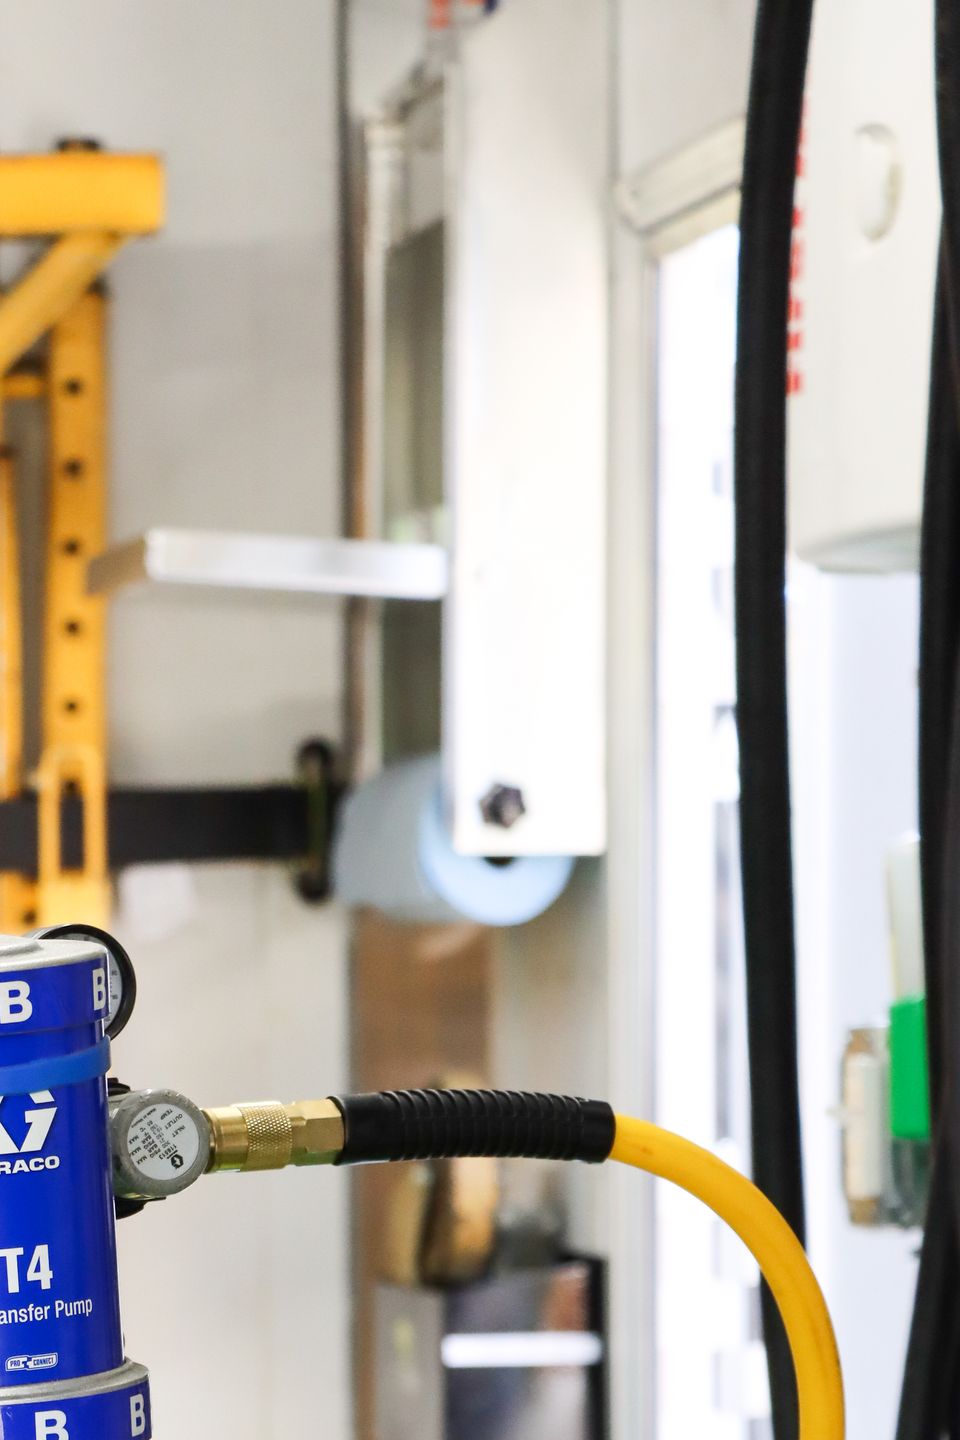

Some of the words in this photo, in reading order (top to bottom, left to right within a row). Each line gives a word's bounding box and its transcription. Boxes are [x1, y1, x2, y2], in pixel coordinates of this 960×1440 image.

[93, 967, 106, 1011] B
[160, 1108, 173, 1120] TEMP
[164, 1113, 183, 1130] OUTLET
[55, 1298, 93, 1318] Pump
[33, 1357, 54, 1366] CONNECT
[130, 1393, 146, 1437] B
